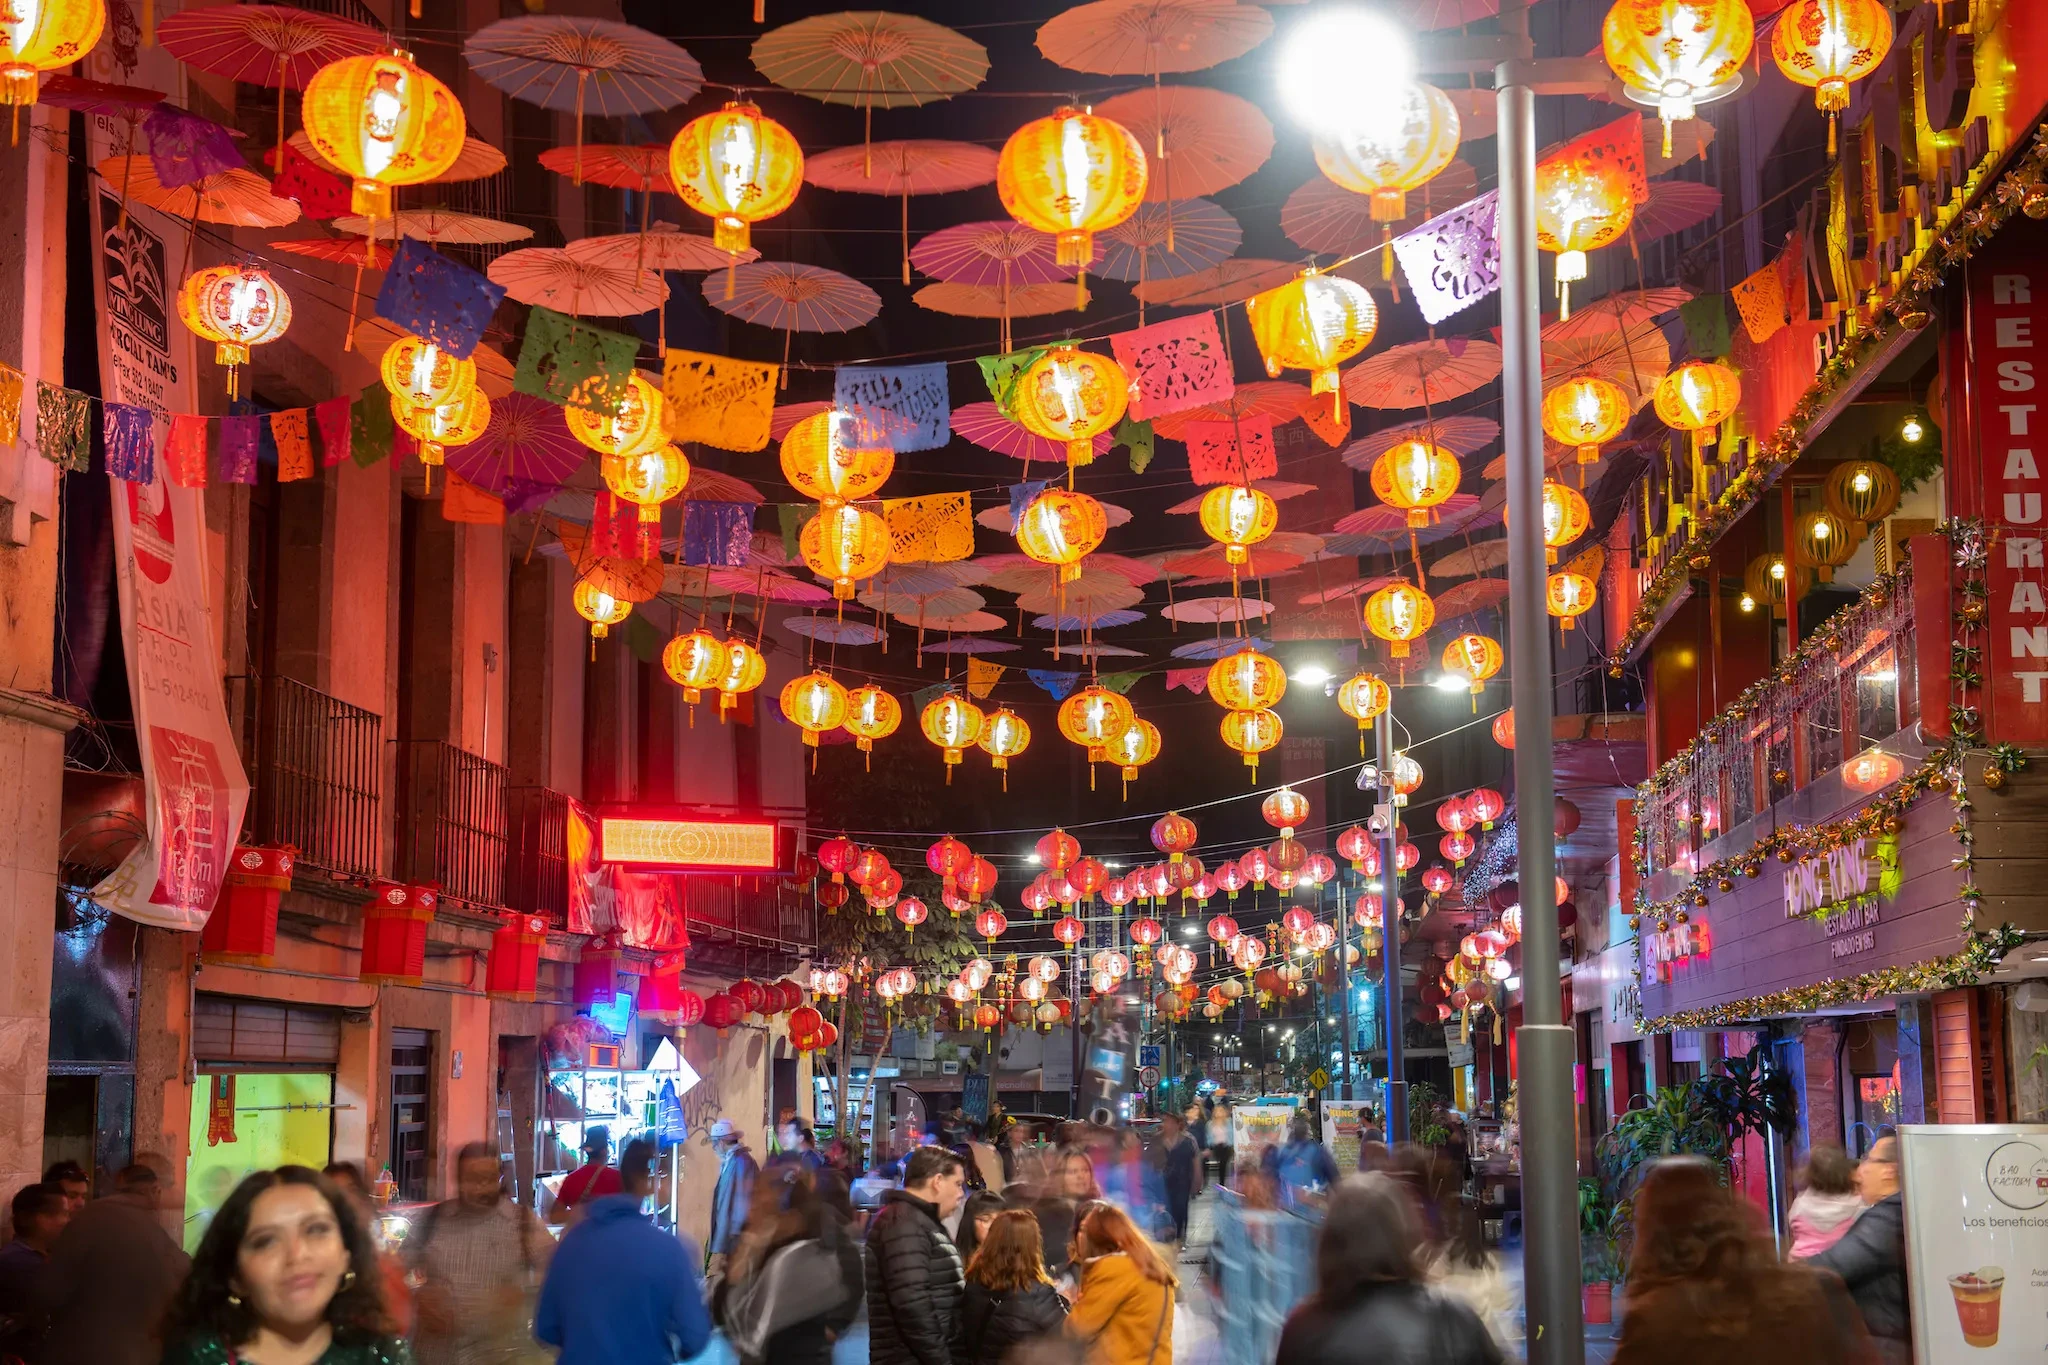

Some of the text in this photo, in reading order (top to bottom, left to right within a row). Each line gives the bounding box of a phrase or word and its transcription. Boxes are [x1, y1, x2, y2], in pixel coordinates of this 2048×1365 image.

[145, 350, 178, 384] TAM'S
[1993, 274, 2048, 703] RESTAURANT
[1783, 857, 1824, 919] HONG
[1864, 901, 1880, 925] BAR
[2000, 1165, 2019, 1175] BAO
[1963, 1216, 1986, 1227] Los
